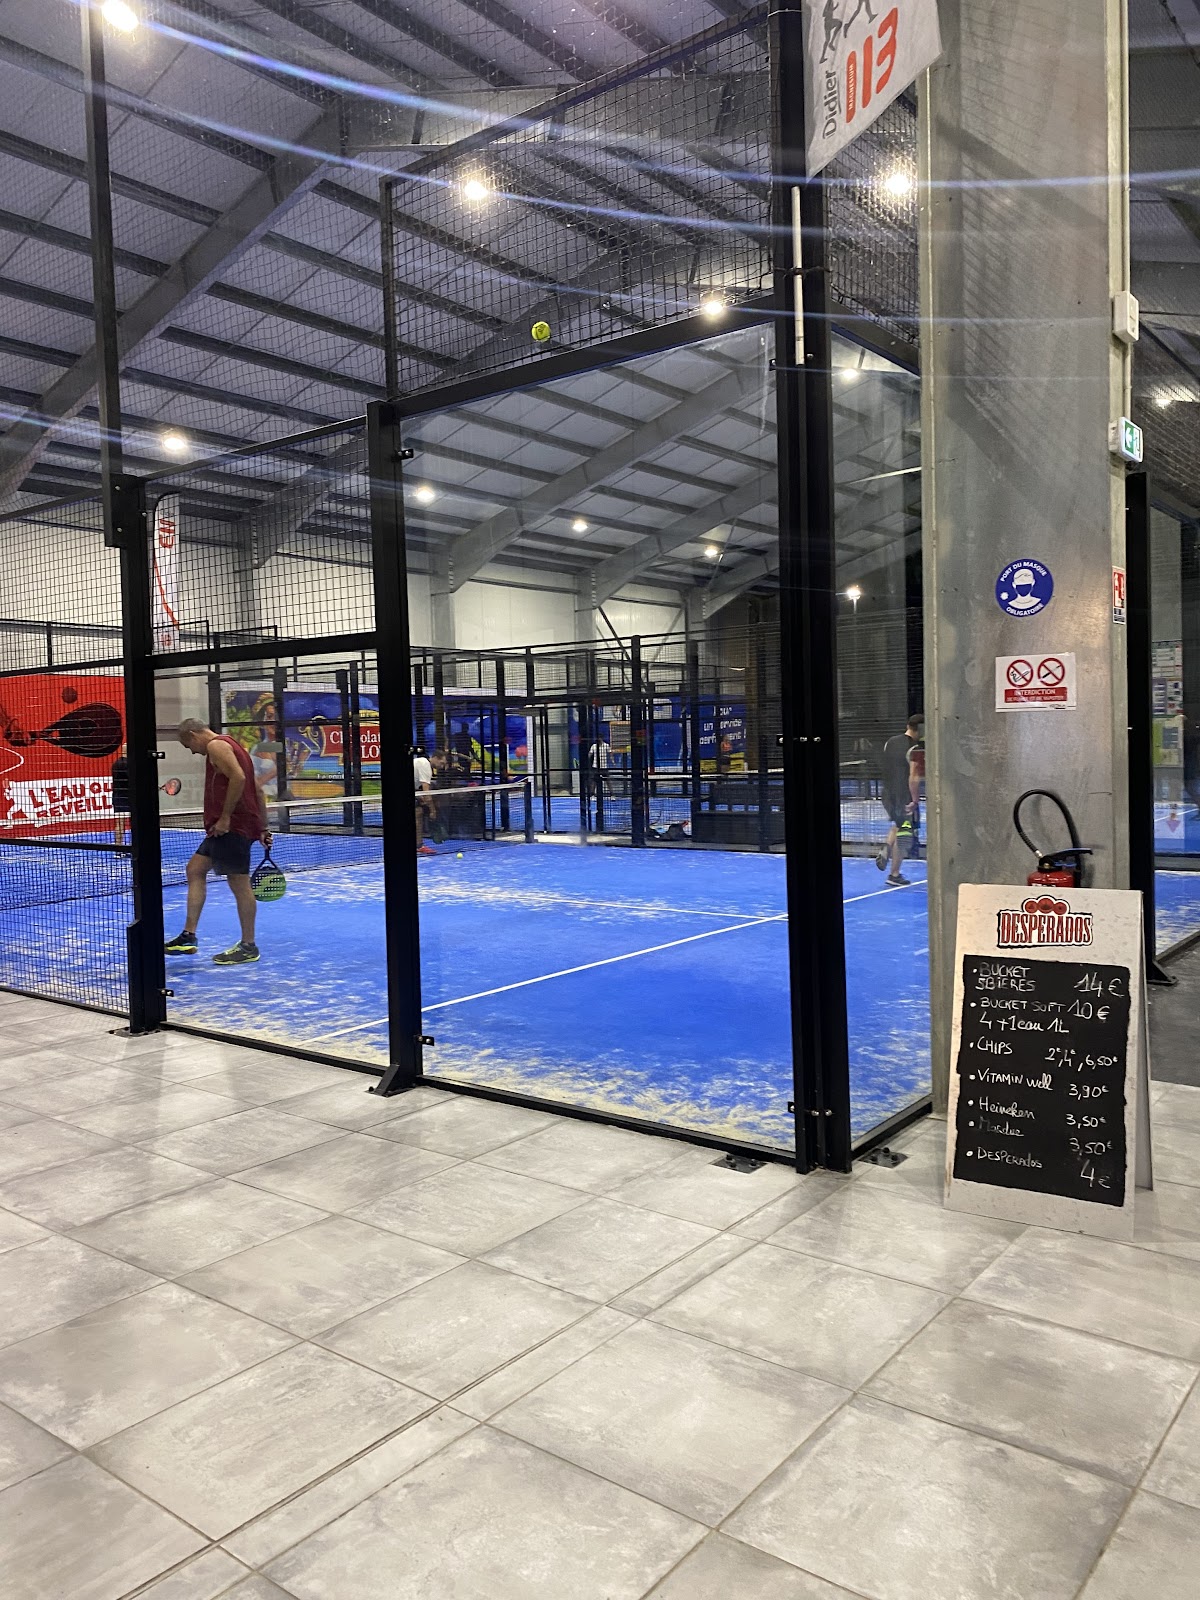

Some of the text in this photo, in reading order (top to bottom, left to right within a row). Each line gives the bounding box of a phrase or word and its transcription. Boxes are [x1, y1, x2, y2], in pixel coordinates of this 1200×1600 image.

[822, 70, 838, 140] Didier
[1000, 567, 1012, 581] PORT
[1023, 561, 1047, 577] MASQUE
[1006, 602, 1044, 616] OBLIGATOIRE
[1014, 688, 1056, 696] INTERDICTION
[28, 782, 113, 808] L'EAU QU
[36, 795, 112, 818] REVEILL
[1001, 912, 1092, 944] DESPERADOS
[979, 962, 1031, 977] BUCKET
[980, 997, 1028, 1010] BUCKET
[1031, 1001, 1067, 1013] SOFT
[977, 1036, 1013, 1055] CHIPS
[979, 1097, 1036, 1120] Heineken
